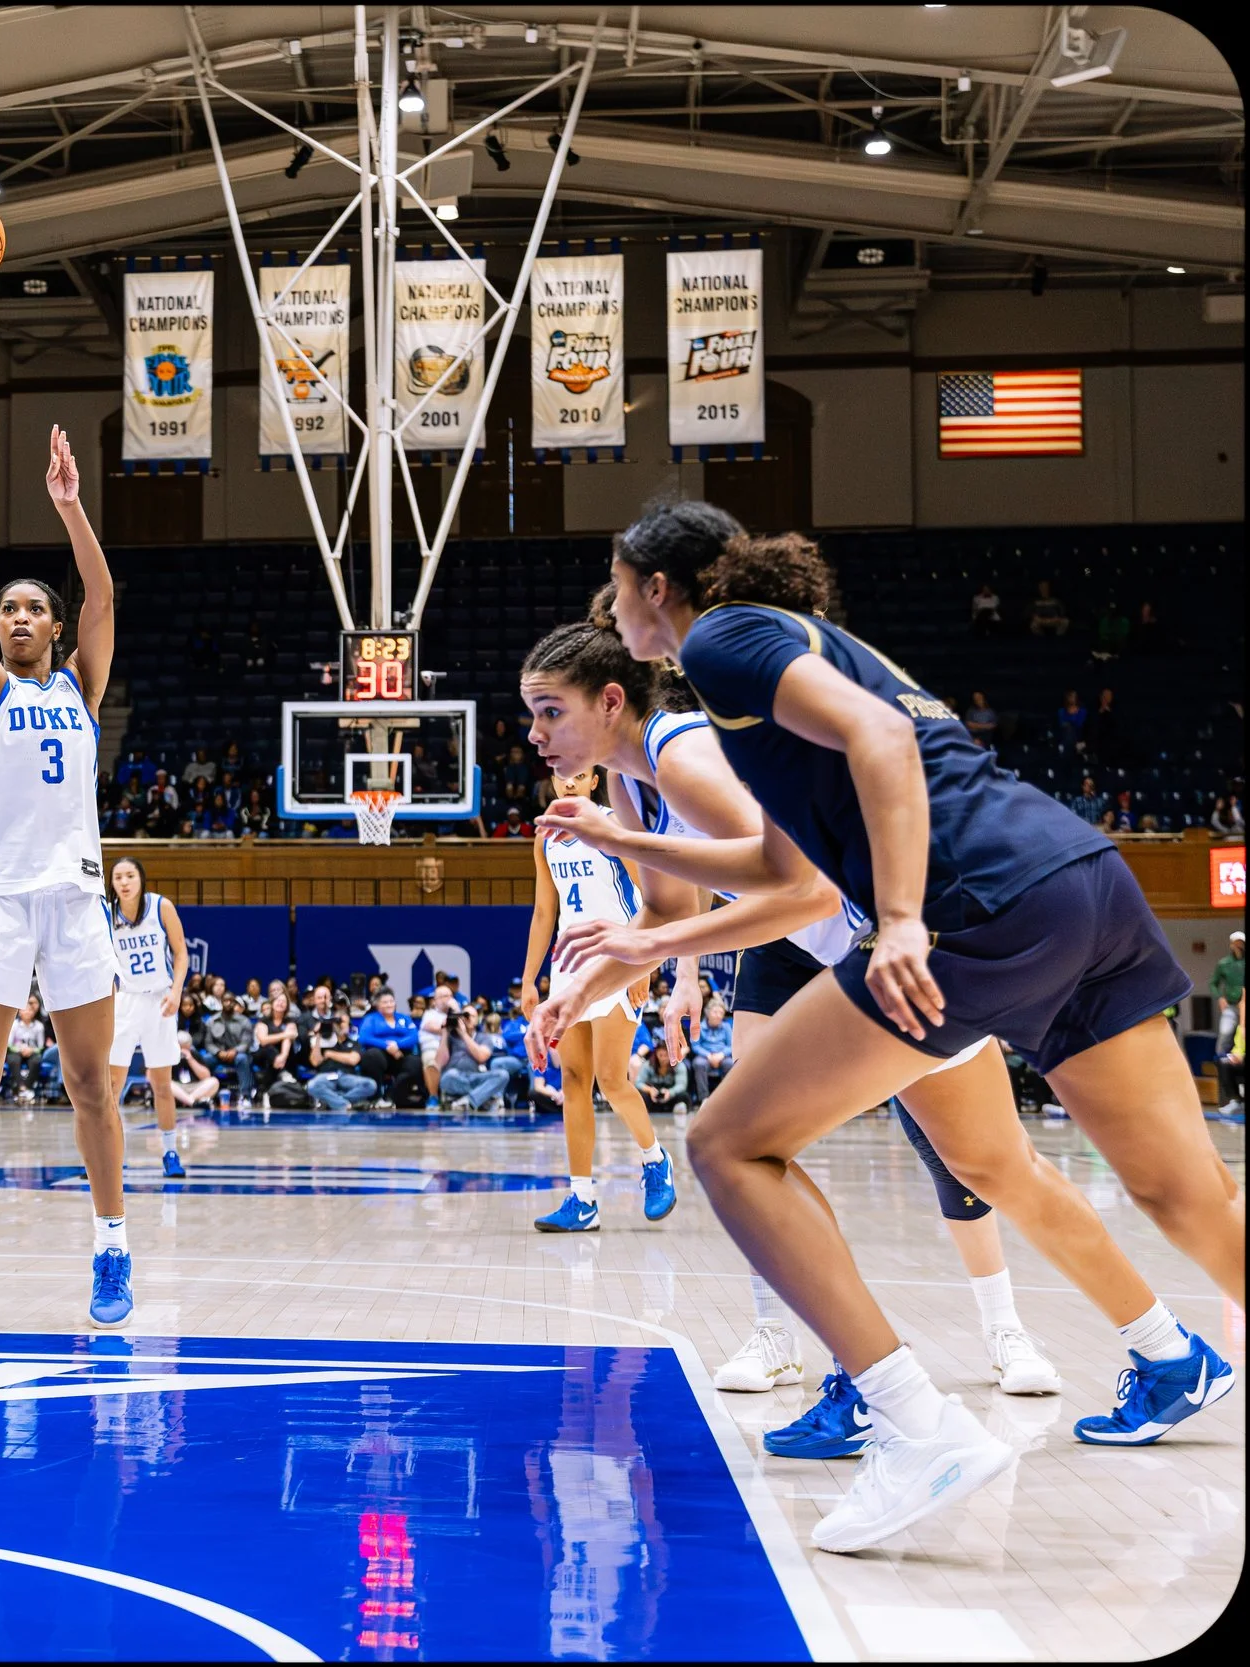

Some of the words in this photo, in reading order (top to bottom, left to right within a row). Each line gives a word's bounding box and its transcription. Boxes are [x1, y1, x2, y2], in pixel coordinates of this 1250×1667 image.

[544, 279, 611, 297] NATIONAL
[682, 274, 749, 292] NATIONAL
[137, 295, 202, 311] NATIONAL
[537, 299, 619, 318] CHAMPIONS
[675, 294, 759, 314] CHAMPIONS
[129, 314, 208, 332] CHAMPIONS
[266, 309, 345, 327] HAMPIONS
[420, 411, 460, 428] 2001
[560, 407, 601, 424] 2010
[697, 404, 740, 421] 2015
[149, 420, 188, 437] 1991
[294, 415, 325, 432] 992
[361, 637, 410, 660] 8:23
[356, 661, 403, 699] 30
[8, 705, 83, 732] DUKE
[40, 738, 65, 785] 3
[567, 883, 583, 913] 4
[118, 933, 159, 951] DUKE
[129, 951, 156, 976] 22
